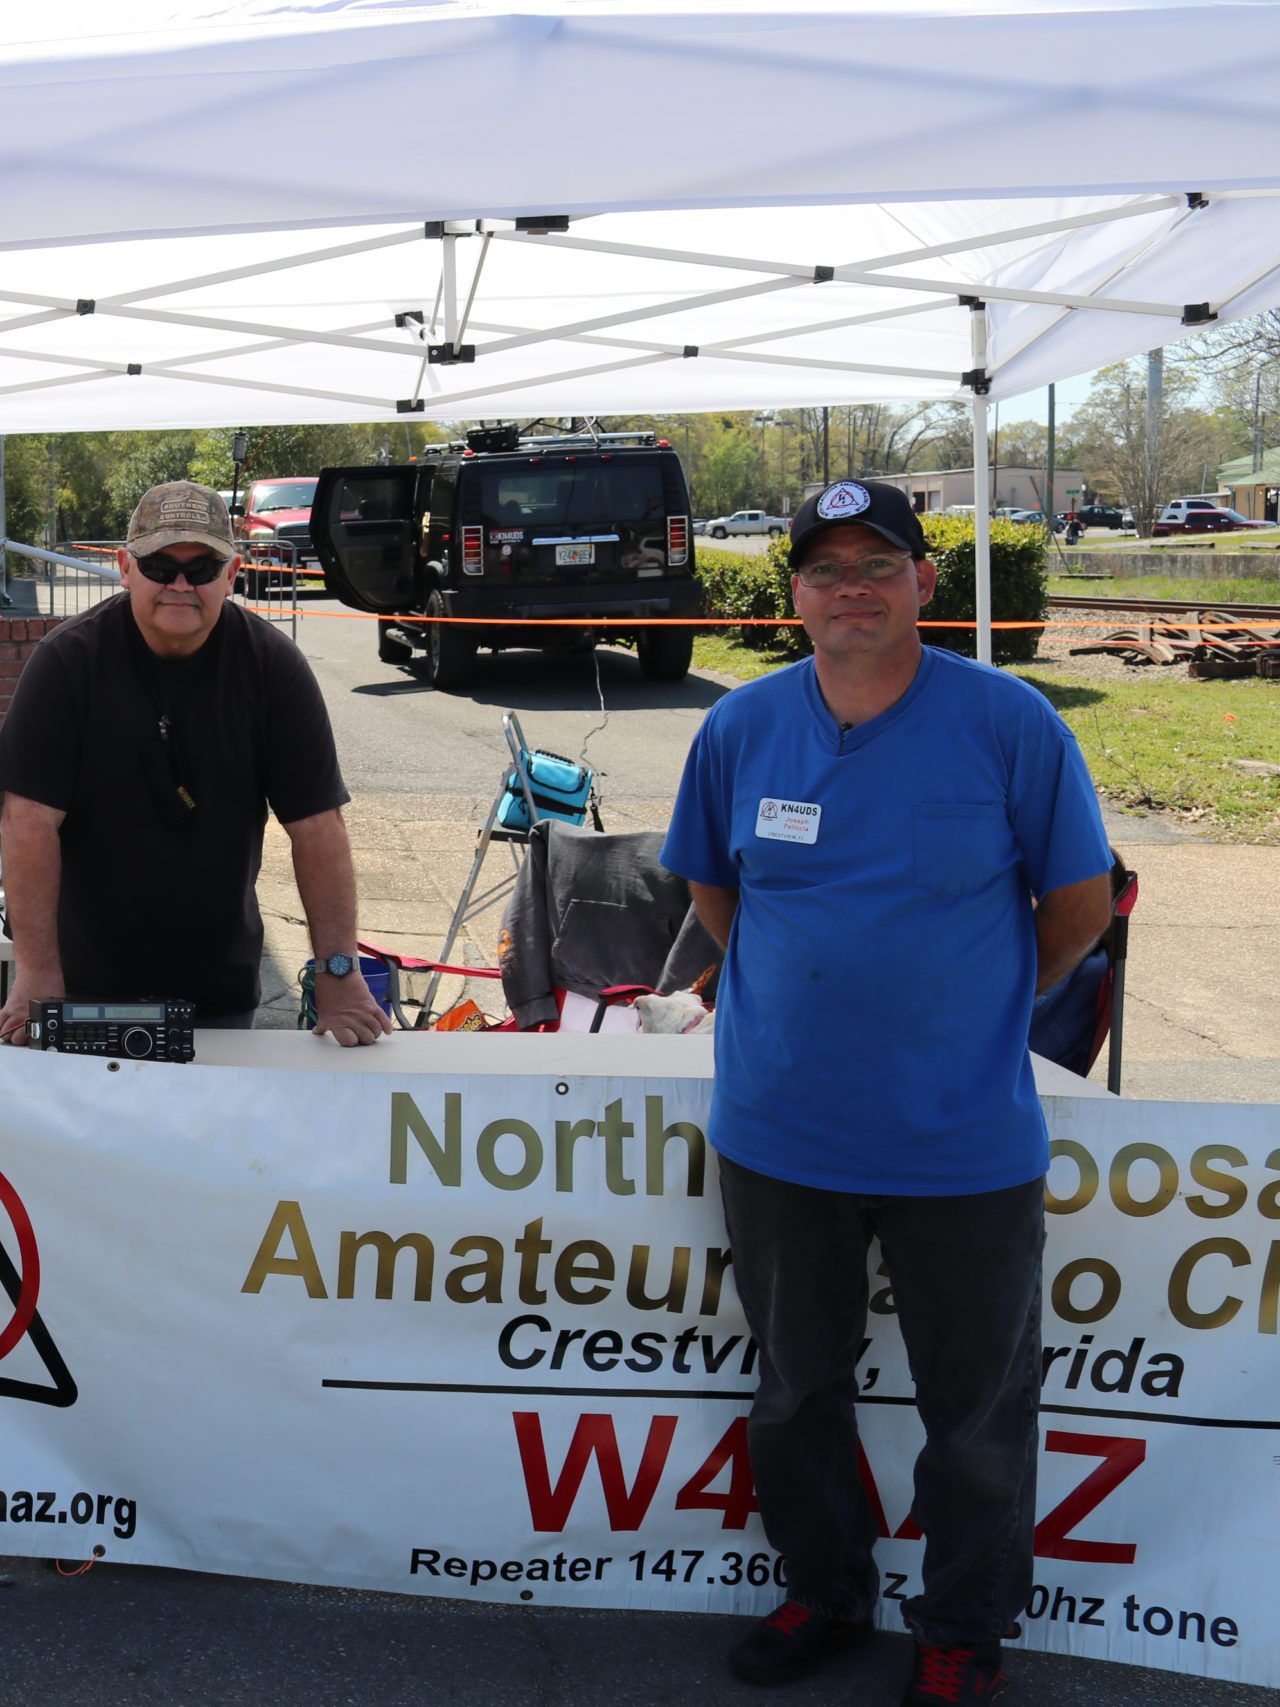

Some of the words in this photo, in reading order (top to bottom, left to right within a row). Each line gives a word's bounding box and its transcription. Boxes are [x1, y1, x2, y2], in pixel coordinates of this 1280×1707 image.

[781, 803, 818, 816] KN4UDS
[389, 1092, 706, 1197] North
[240, 1200, 732, 1316] Amateur
[1041, 1335, 1185, 1398] rida
[512, 1411, 1146, 1564] W4Z
[409, 1548, 612, 1586] Repeater
[1123, 1594, 1239, 1648] tone
